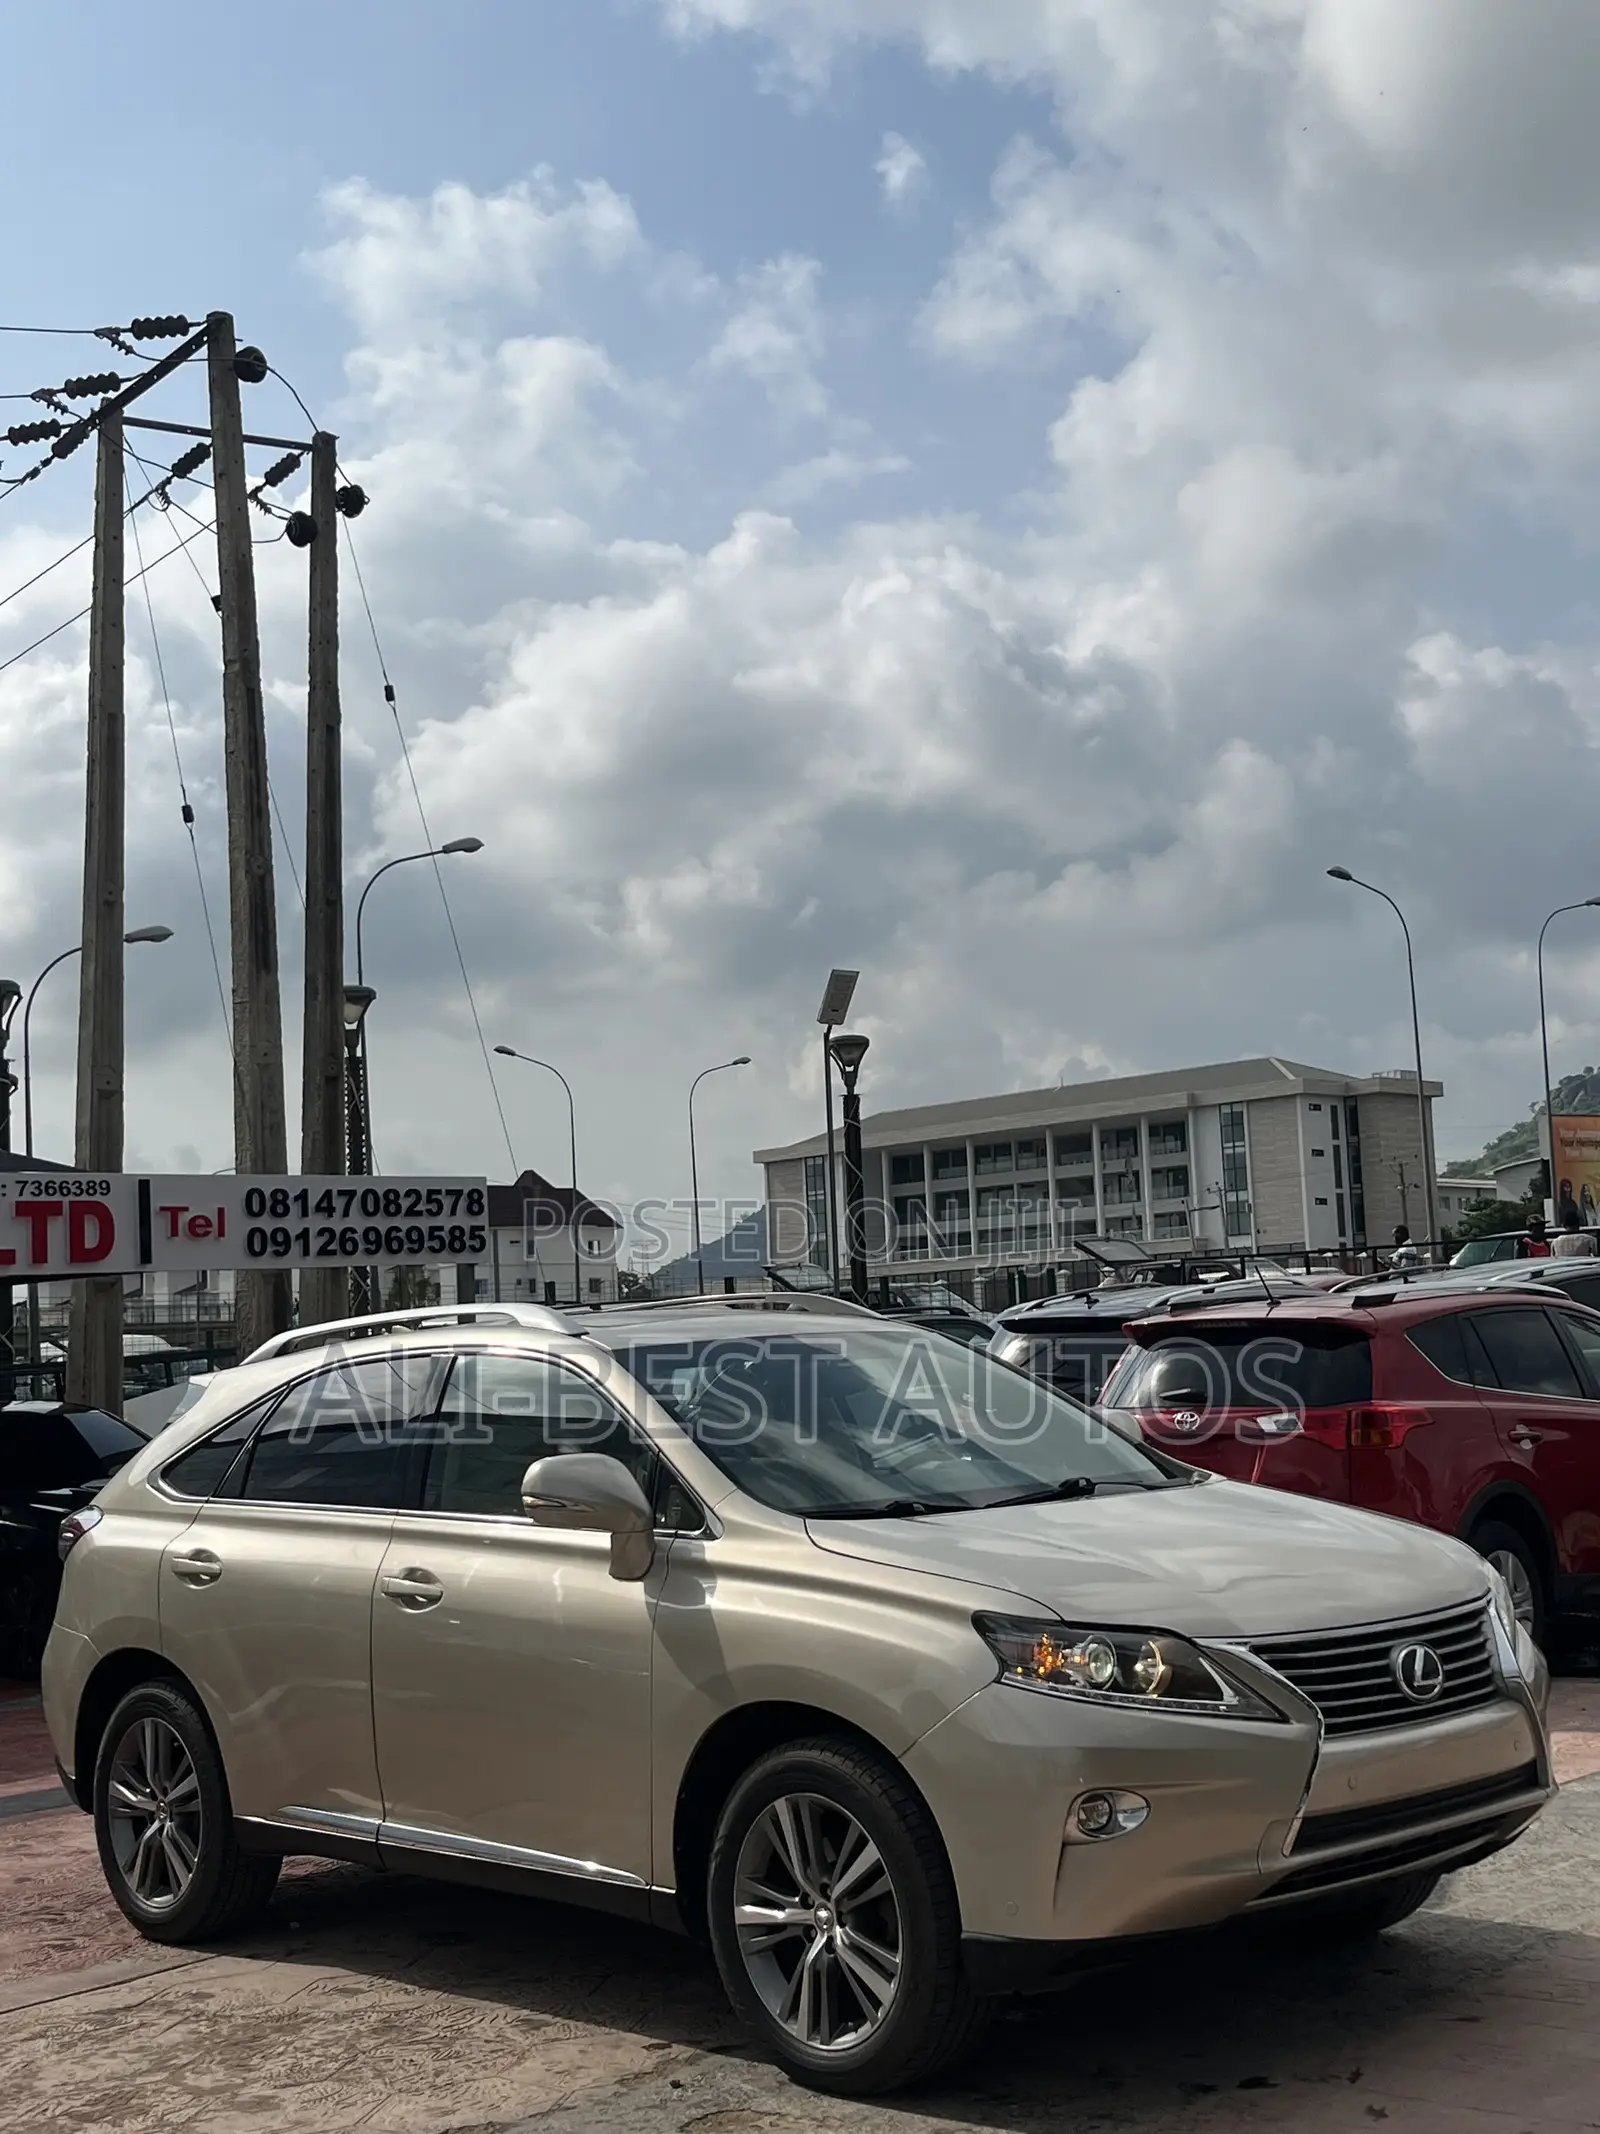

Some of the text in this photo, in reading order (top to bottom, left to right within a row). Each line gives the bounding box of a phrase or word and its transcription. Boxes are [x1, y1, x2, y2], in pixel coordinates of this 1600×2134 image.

[15, 1180, 111, 1197] 7366389
[244, 1187, 486, 1218] 08147082578
[158, 1205, 226, 1239] Tel
[246, 1225, 487, 1257] 09126969585
